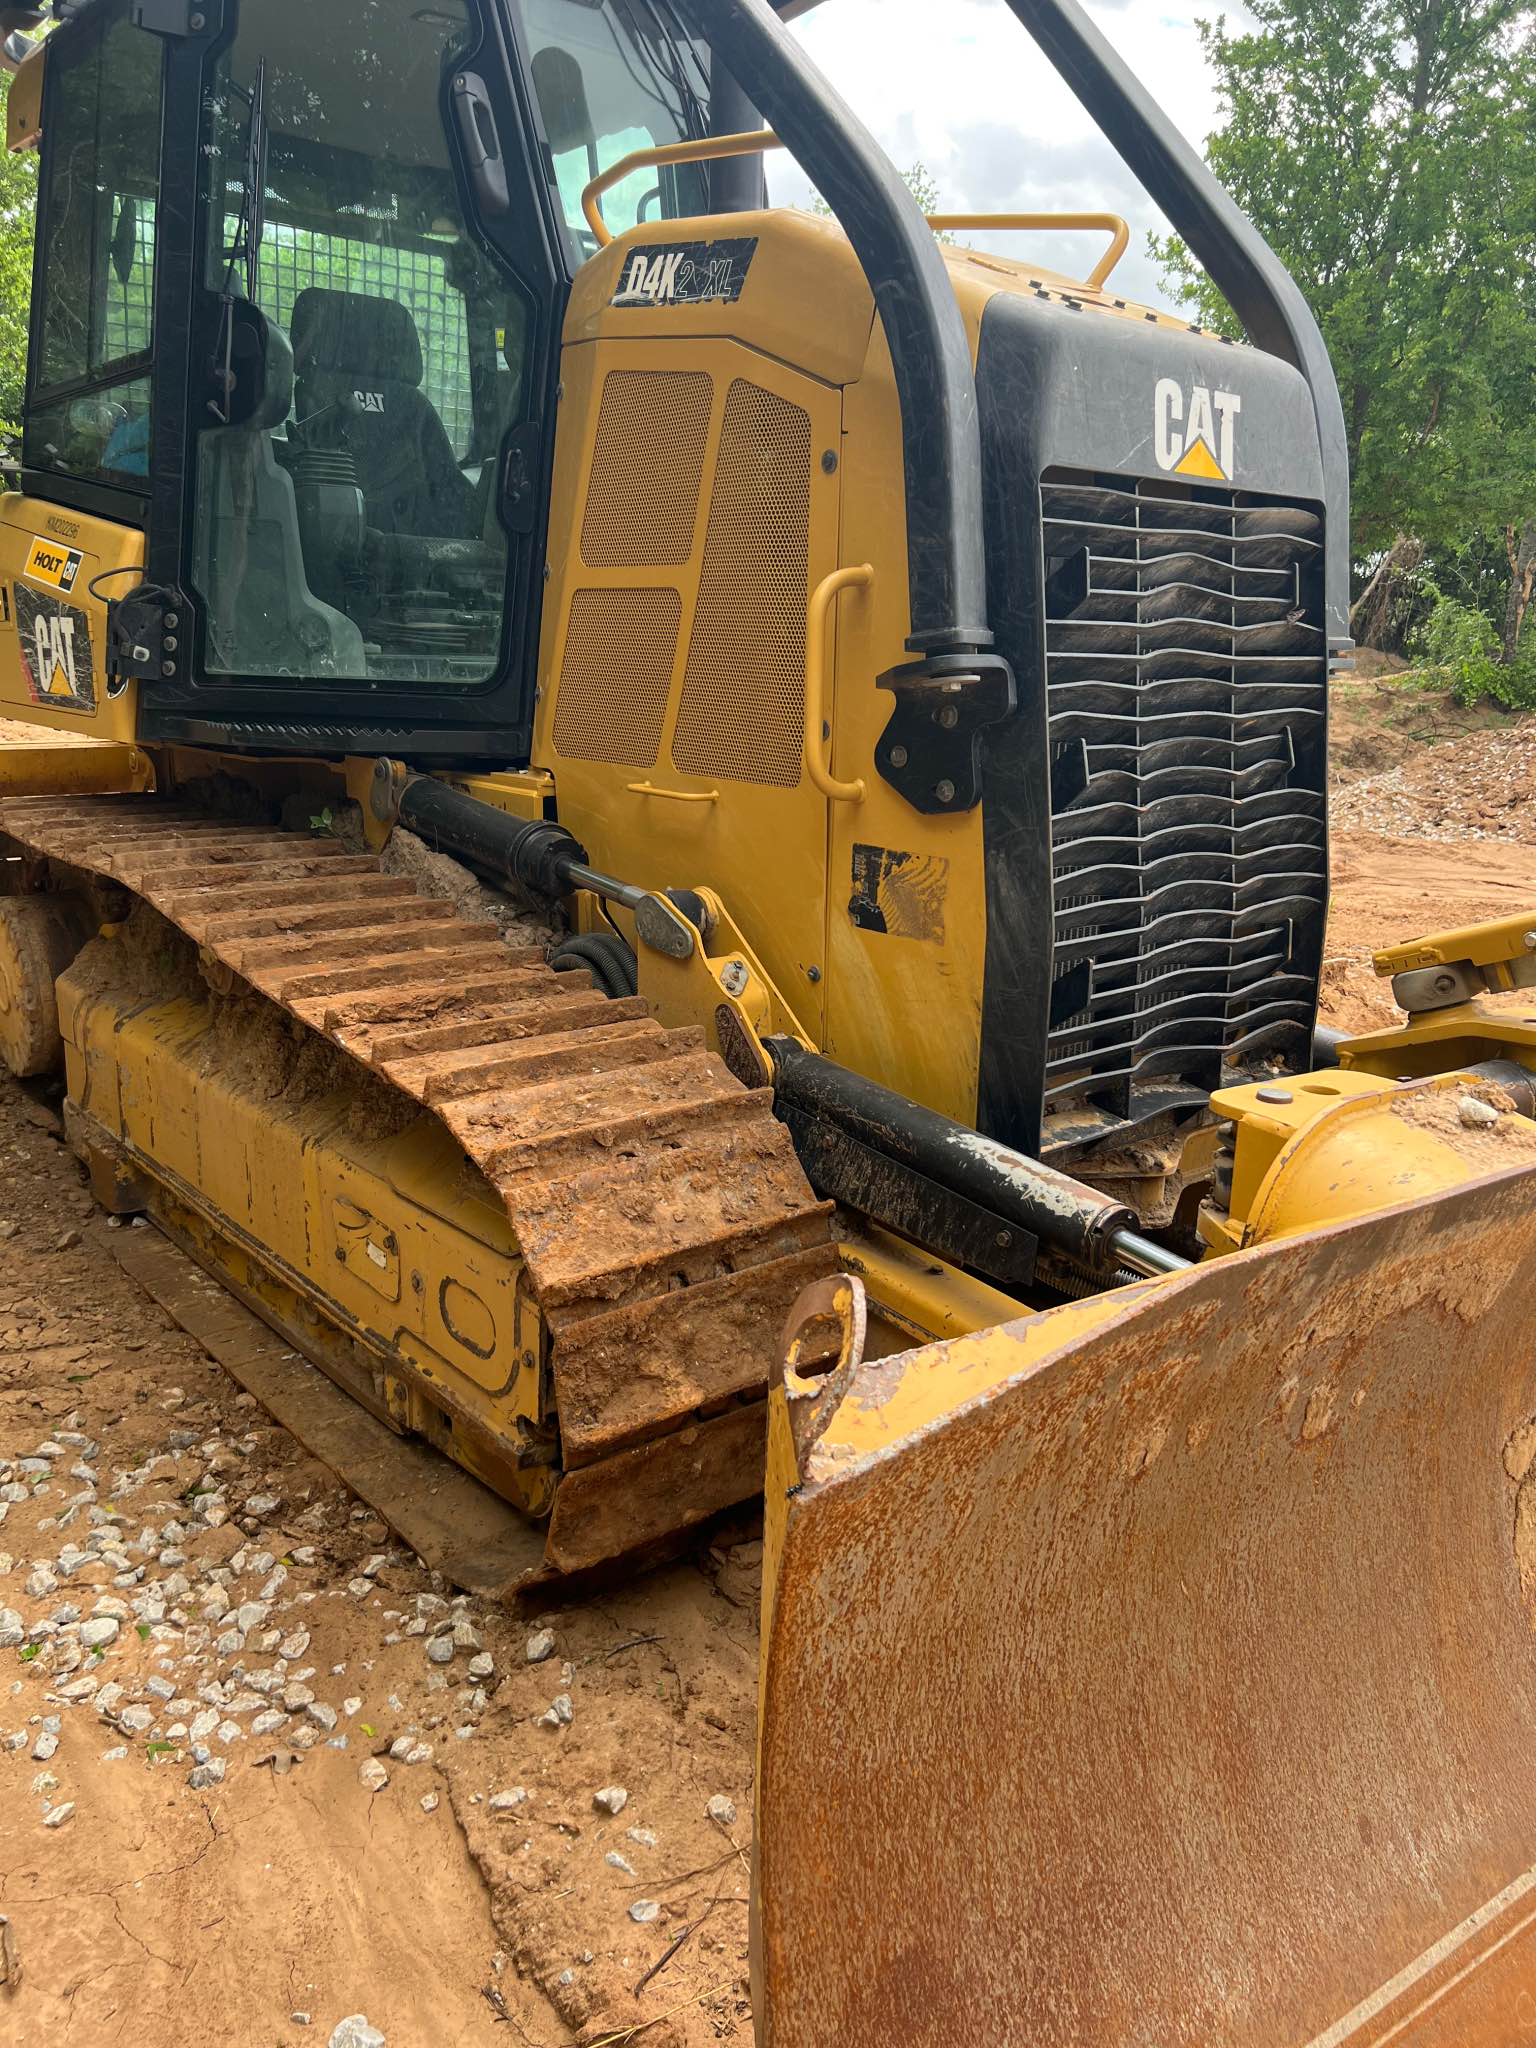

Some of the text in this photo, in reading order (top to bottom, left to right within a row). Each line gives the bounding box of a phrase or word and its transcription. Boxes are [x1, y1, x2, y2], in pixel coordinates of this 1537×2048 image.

[702, 259, 733, 298] XL
[353, 390, 385, 413] CAT
[1154, 377, 1241, 481] CAT
[33, 551, 78, 581] HOLT CAT
[35, 614, 78, 697] CAT
